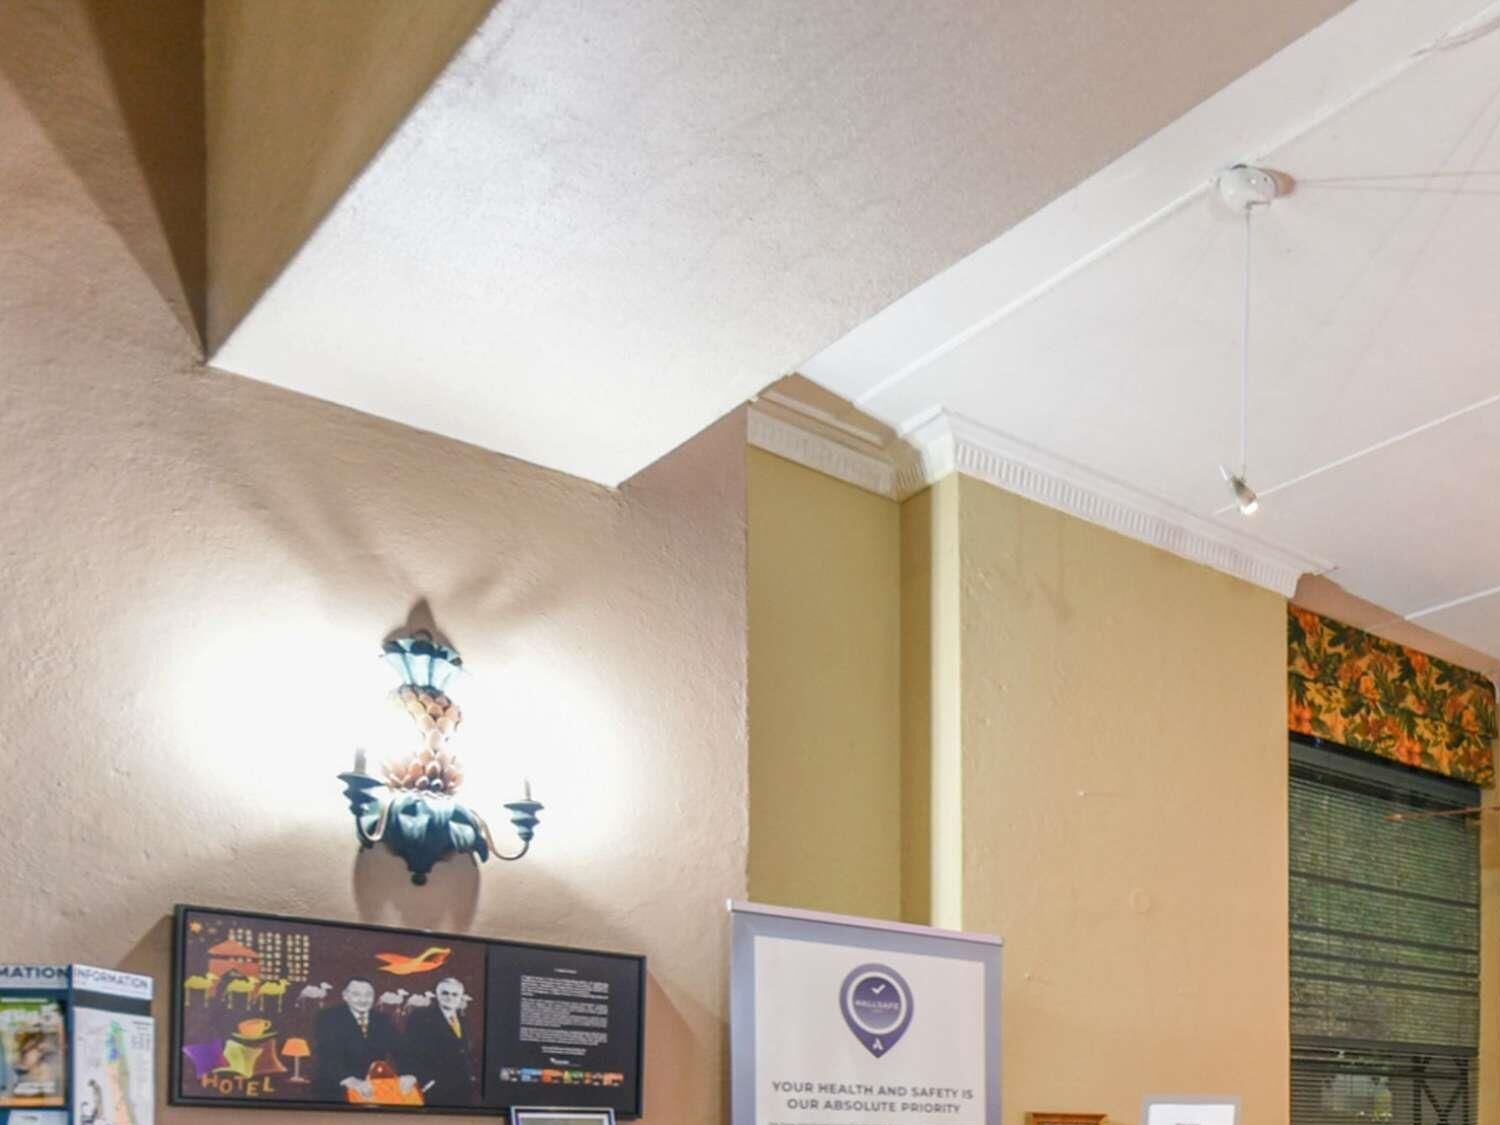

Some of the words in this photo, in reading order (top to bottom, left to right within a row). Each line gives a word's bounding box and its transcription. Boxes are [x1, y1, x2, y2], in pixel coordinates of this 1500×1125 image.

[202, 1071, 275, 1097] HOTEL
[771, 1081, 814, 1093] YOUR
[818, 1083, 873, 1095] HEALTH
[878, 1086, 908, 1097] AND
[911, 1087, 957, 1099] SAFETY
[962, 1088, 974, 1100] IS
[787, 1098, 818, 1110] OUR
[823, 1100, 896, 1112] ABSOLUTE
[901, 1102, 961, 1114] PRIORITY
